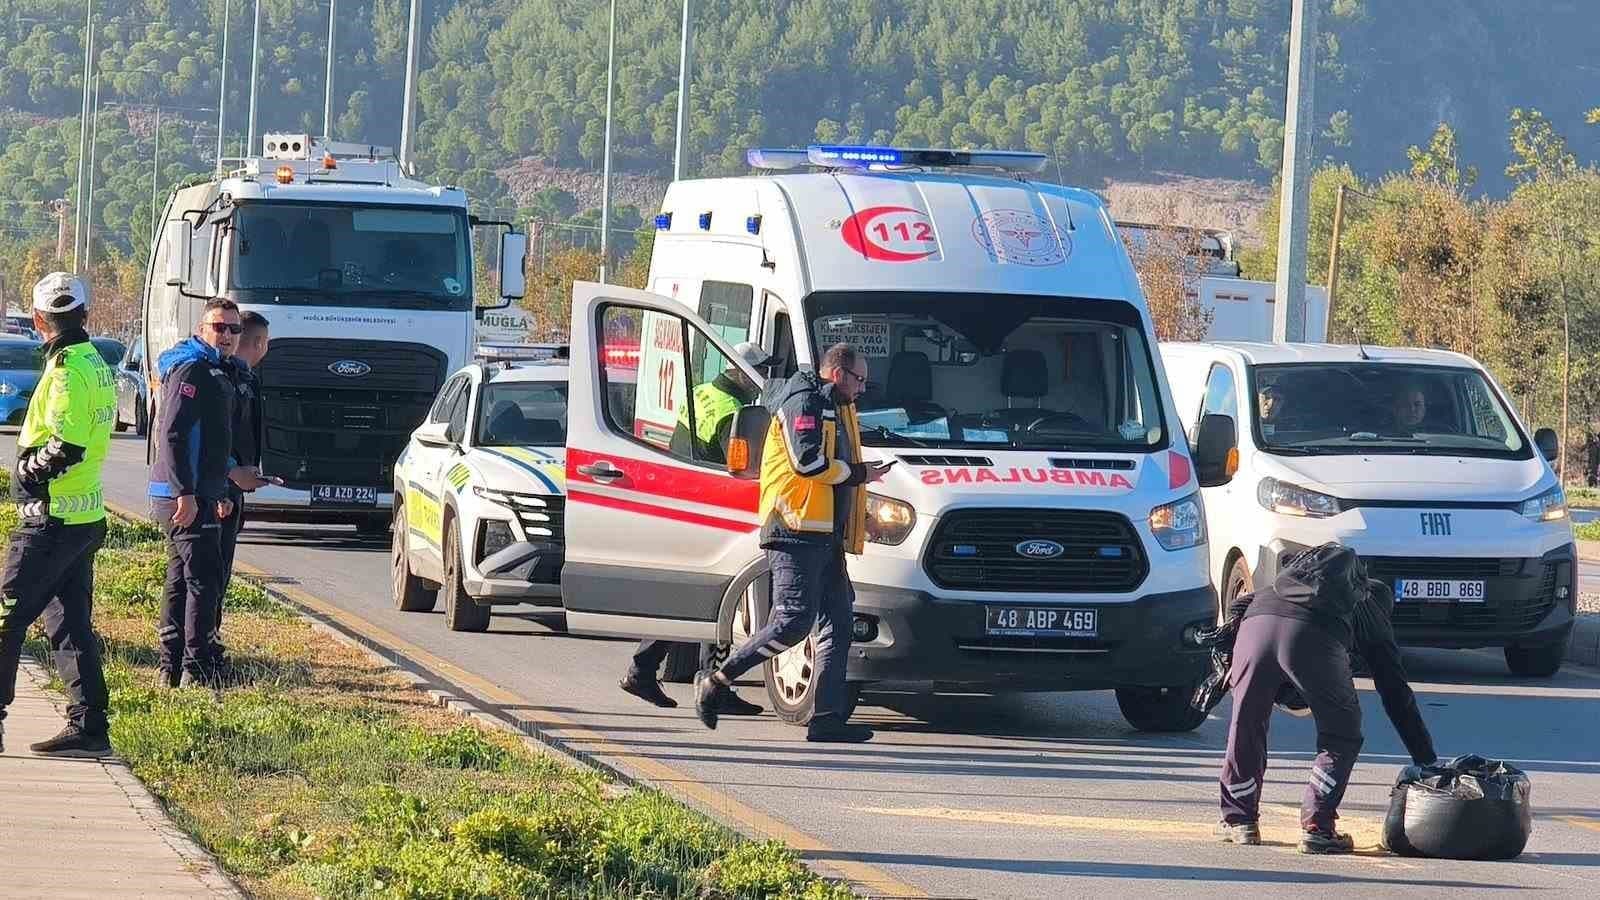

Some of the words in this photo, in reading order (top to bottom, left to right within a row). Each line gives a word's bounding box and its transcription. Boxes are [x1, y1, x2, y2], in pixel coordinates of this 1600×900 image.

[872, 221, 935, 242] 112
[845, 334, 860, 344] VE
[658, 358, 675, 412] 112
[318, 486, 331, 499] 48
[356, 487, 374, 500] 224
[1419, 512, 1452, 536] FIAT
[1026, 542, 1055, 555] Ford
[1403, 581, 1419, 597] 48
[1459, 582, 1483, 597] 869
[997, 609, 1018, 628] 48
[1026, 610, 1058, 629] ABP
[1063, 611, 1094, 630] 469
